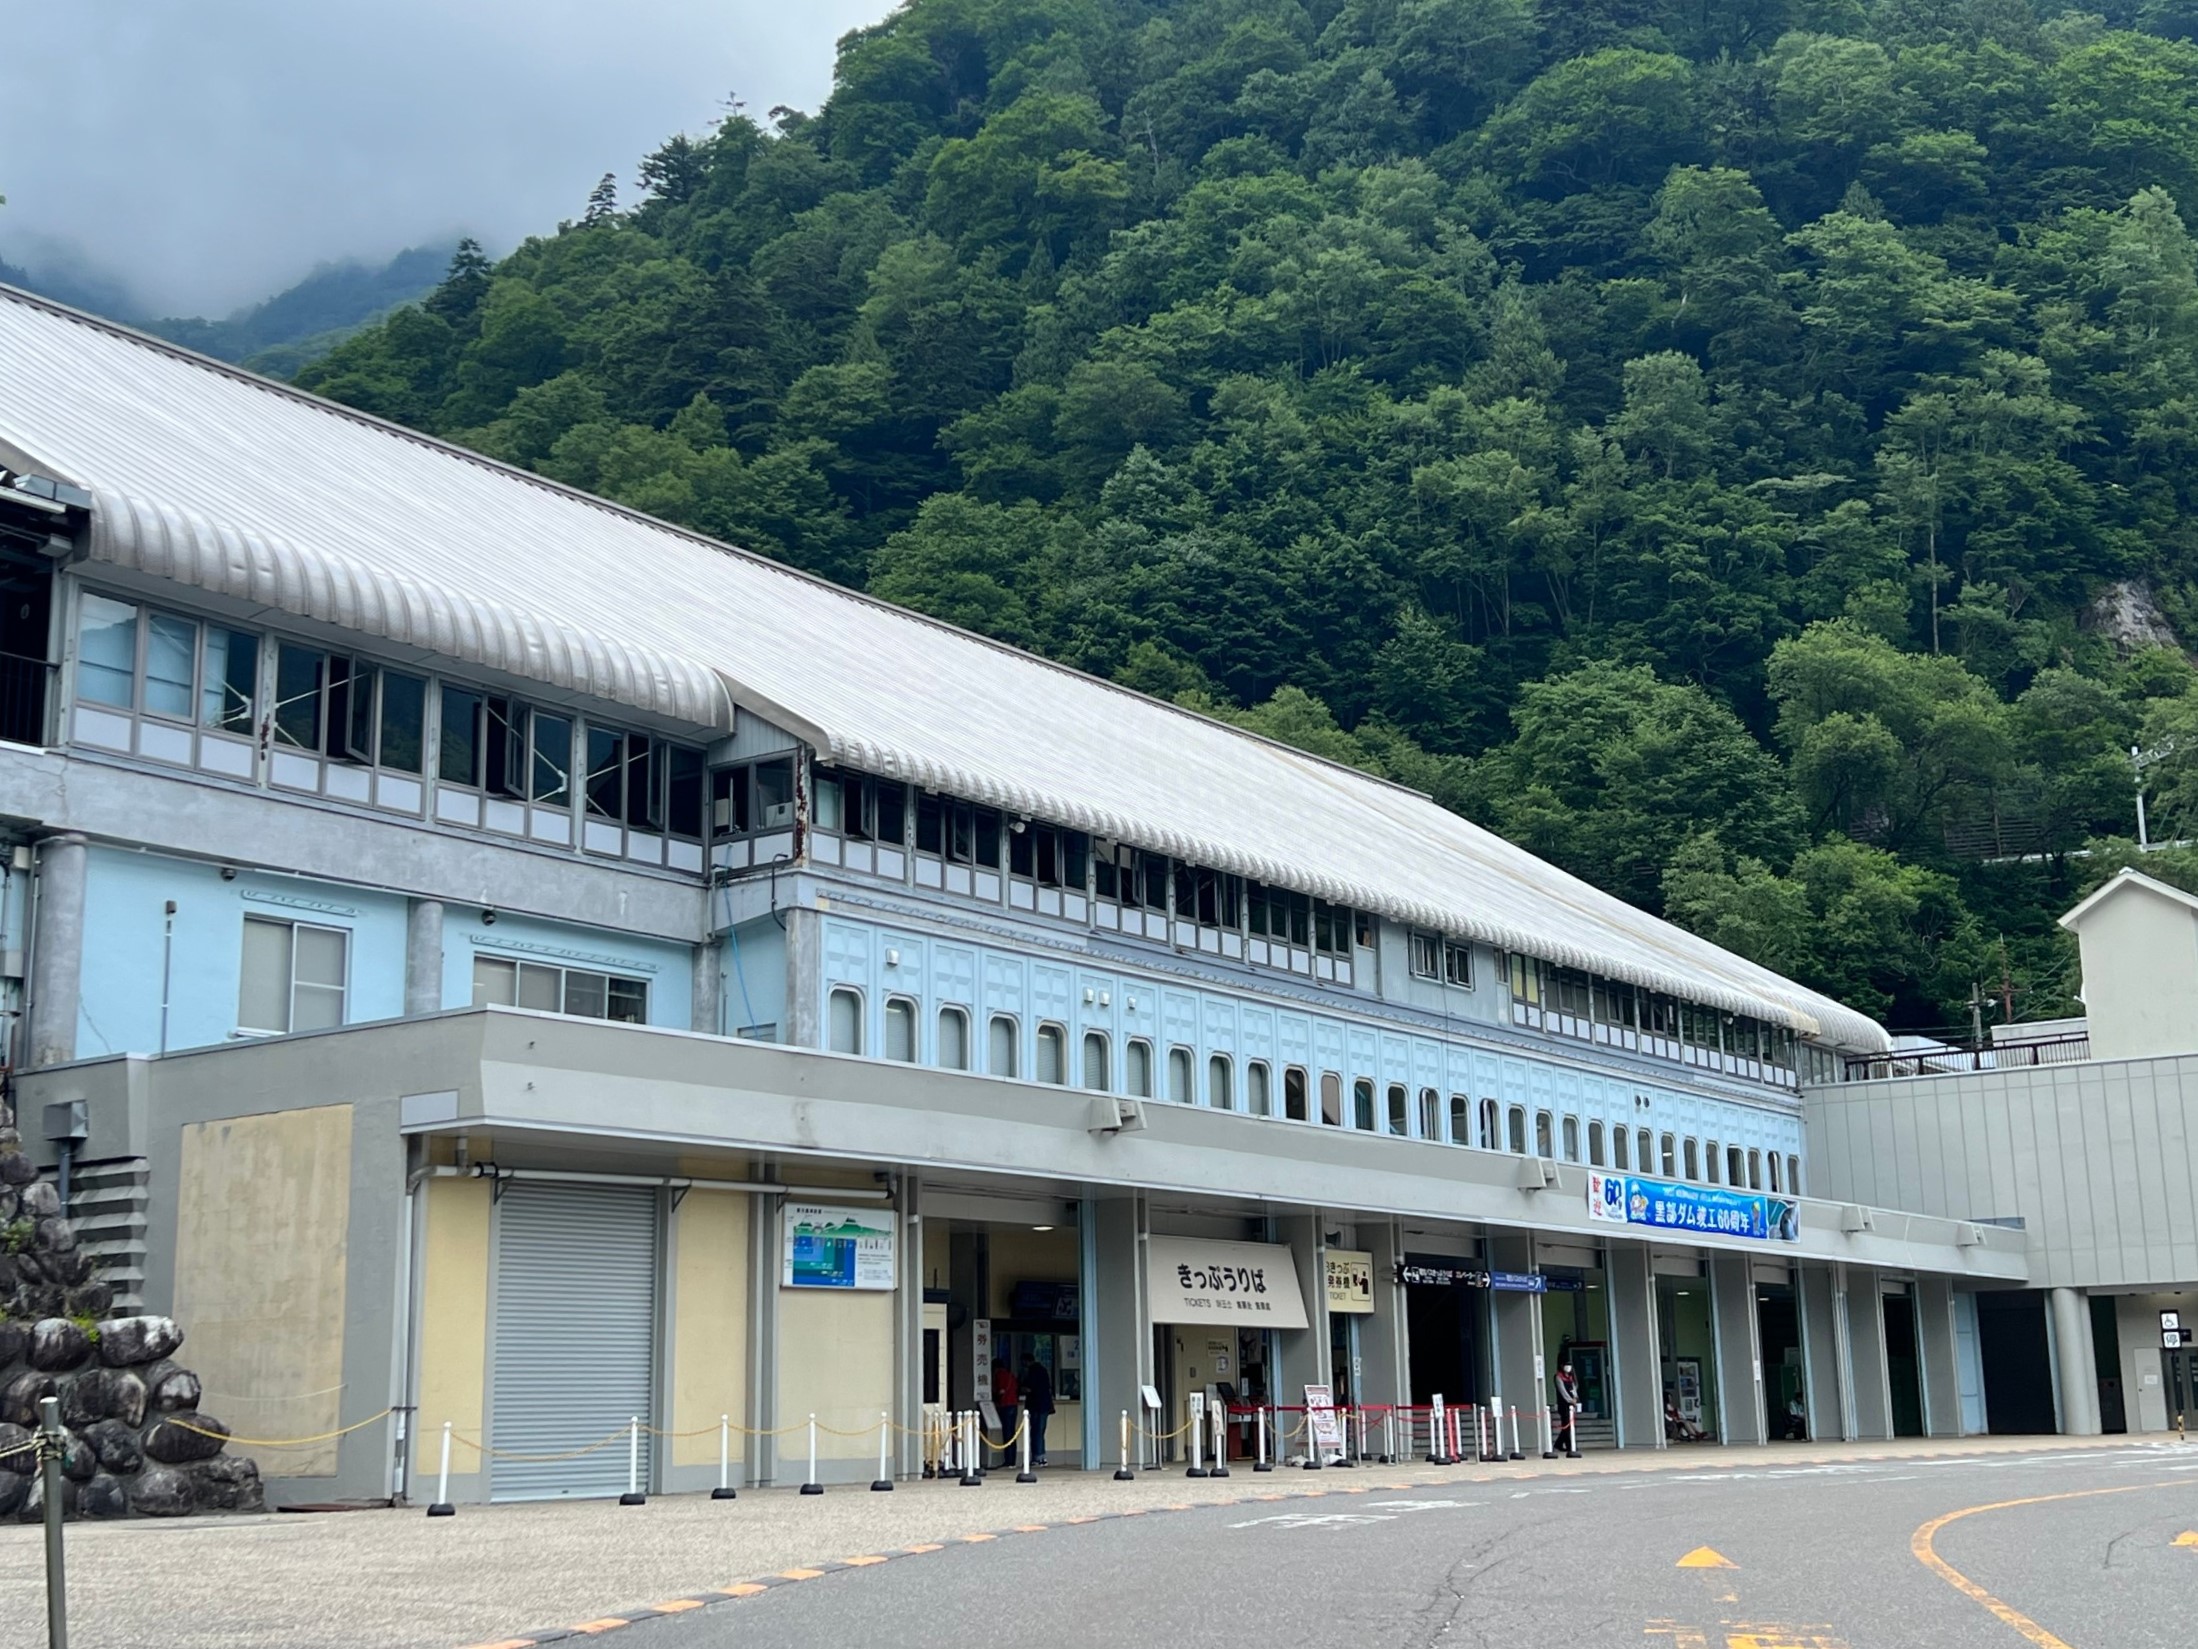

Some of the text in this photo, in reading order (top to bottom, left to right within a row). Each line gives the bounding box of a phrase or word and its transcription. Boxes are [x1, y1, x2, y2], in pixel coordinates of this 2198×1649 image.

[1654, 1200, 1751, 1234] 黒部ダム竣工60周年
[1177, 1262, 1267, 1294] きっぷうりば
[1183, 1297, 1212, 1308] TICKETS
[977, 1333, 989, 1387] 券売機
